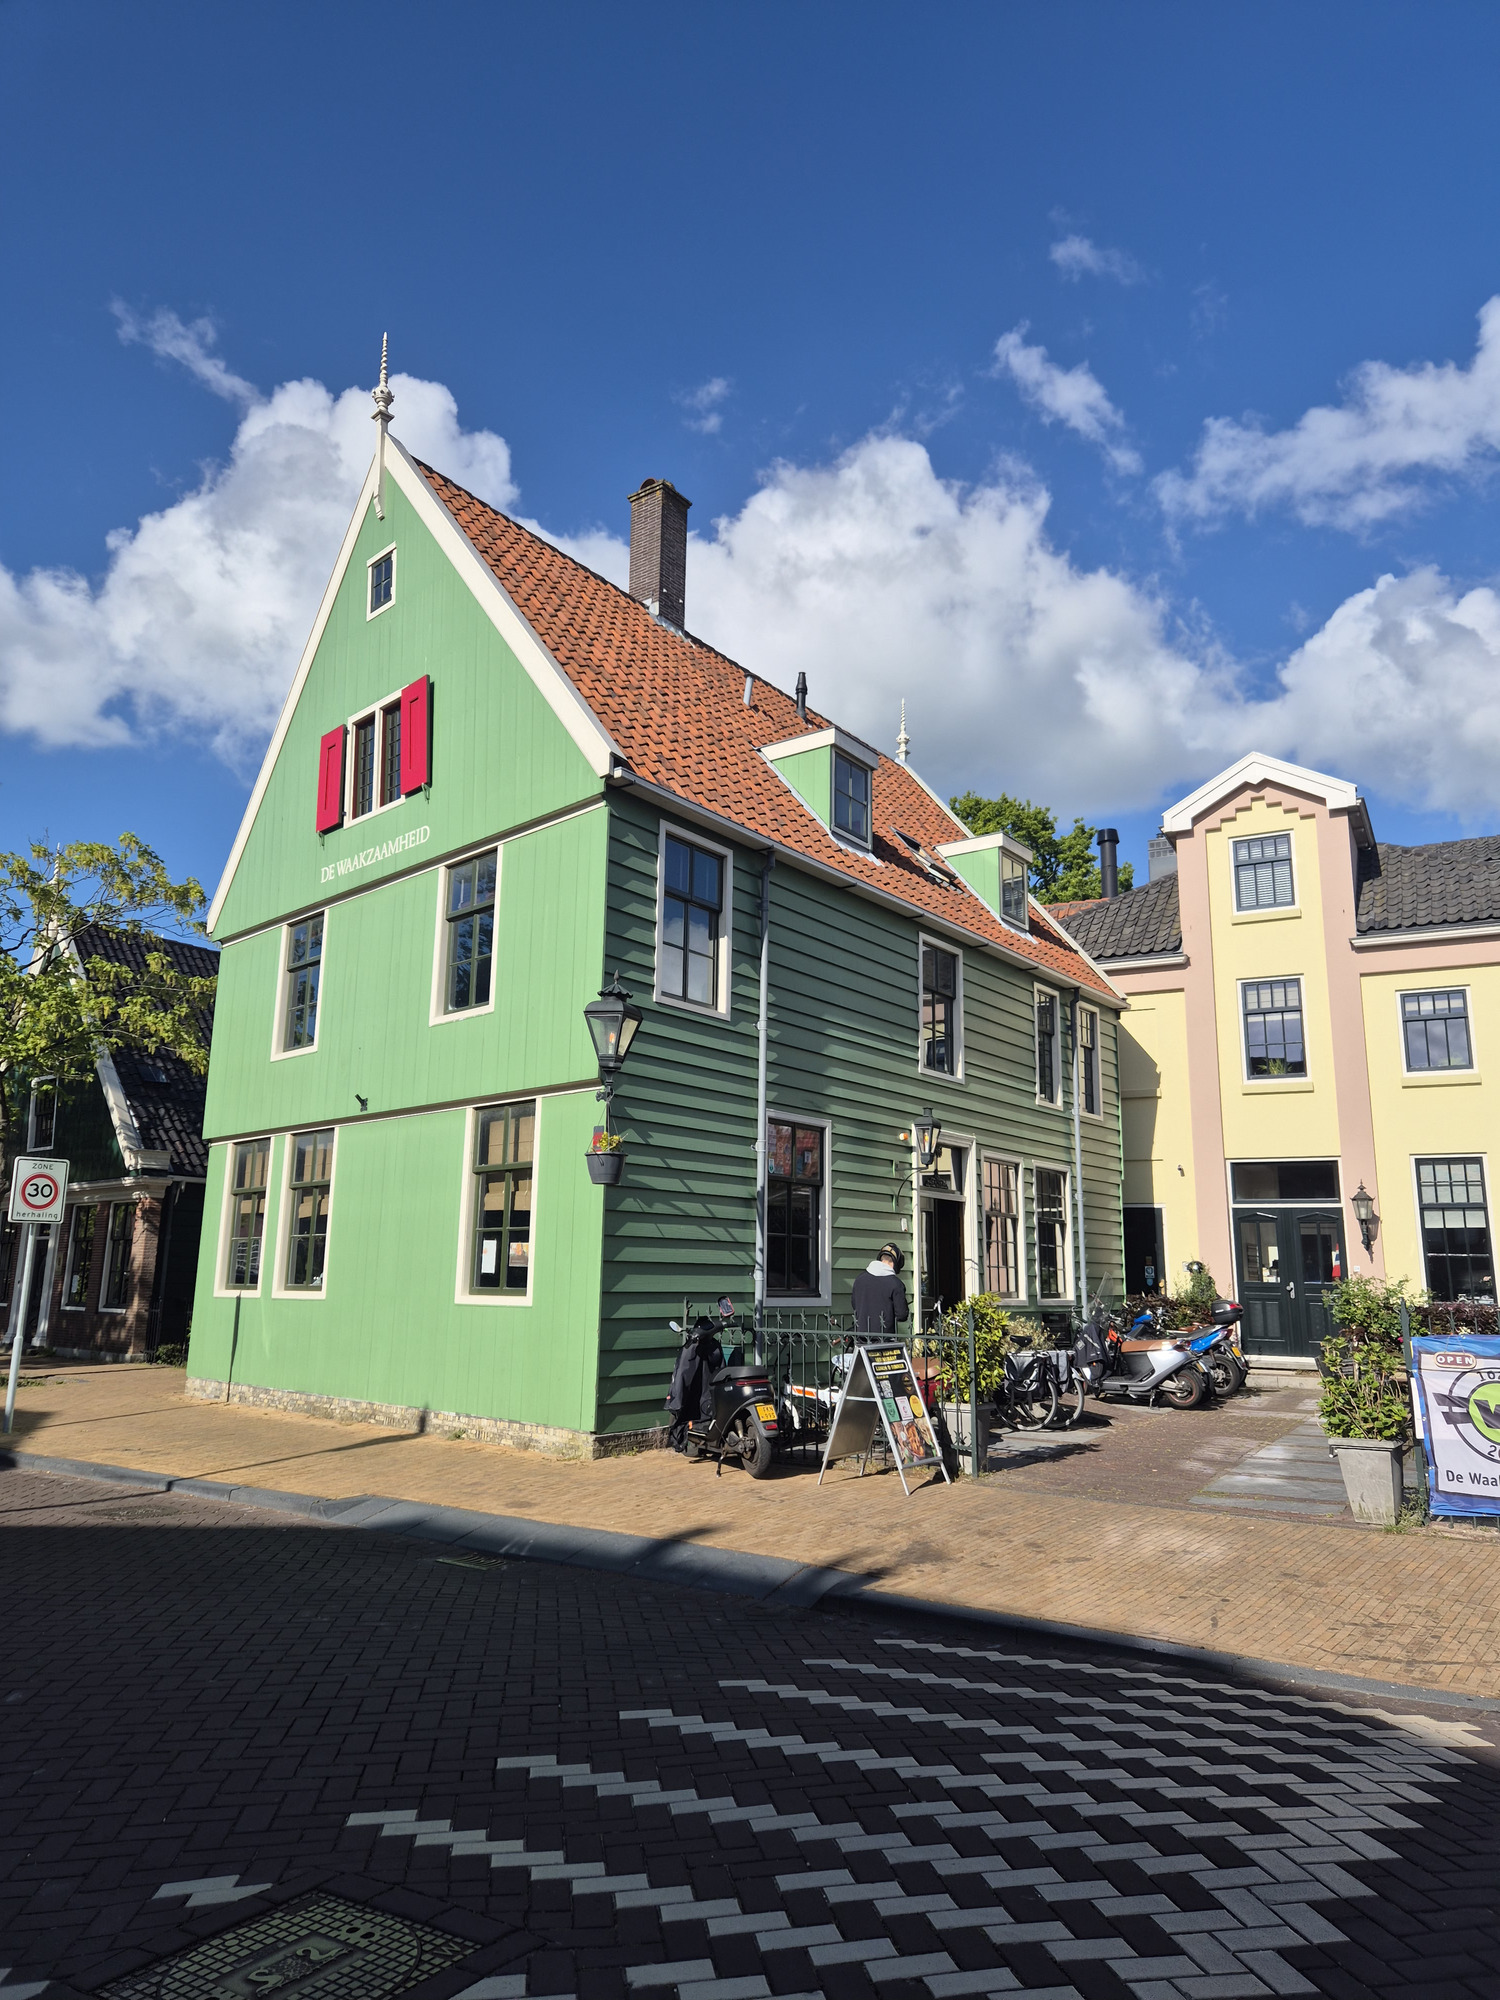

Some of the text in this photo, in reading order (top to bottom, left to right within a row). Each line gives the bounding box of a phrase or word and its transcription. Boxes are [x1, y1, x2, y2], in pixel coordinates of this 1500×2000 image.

[320, 825, 430, 883] DE WAAKZAAMHEID
[27, 1183, 53, 1198] 30
[16, 1211, 58, 1220] herhaling
[1436, 1355, 1474, 1365] OPEN
[1446, 1469, 1500, 1487] De Waa
